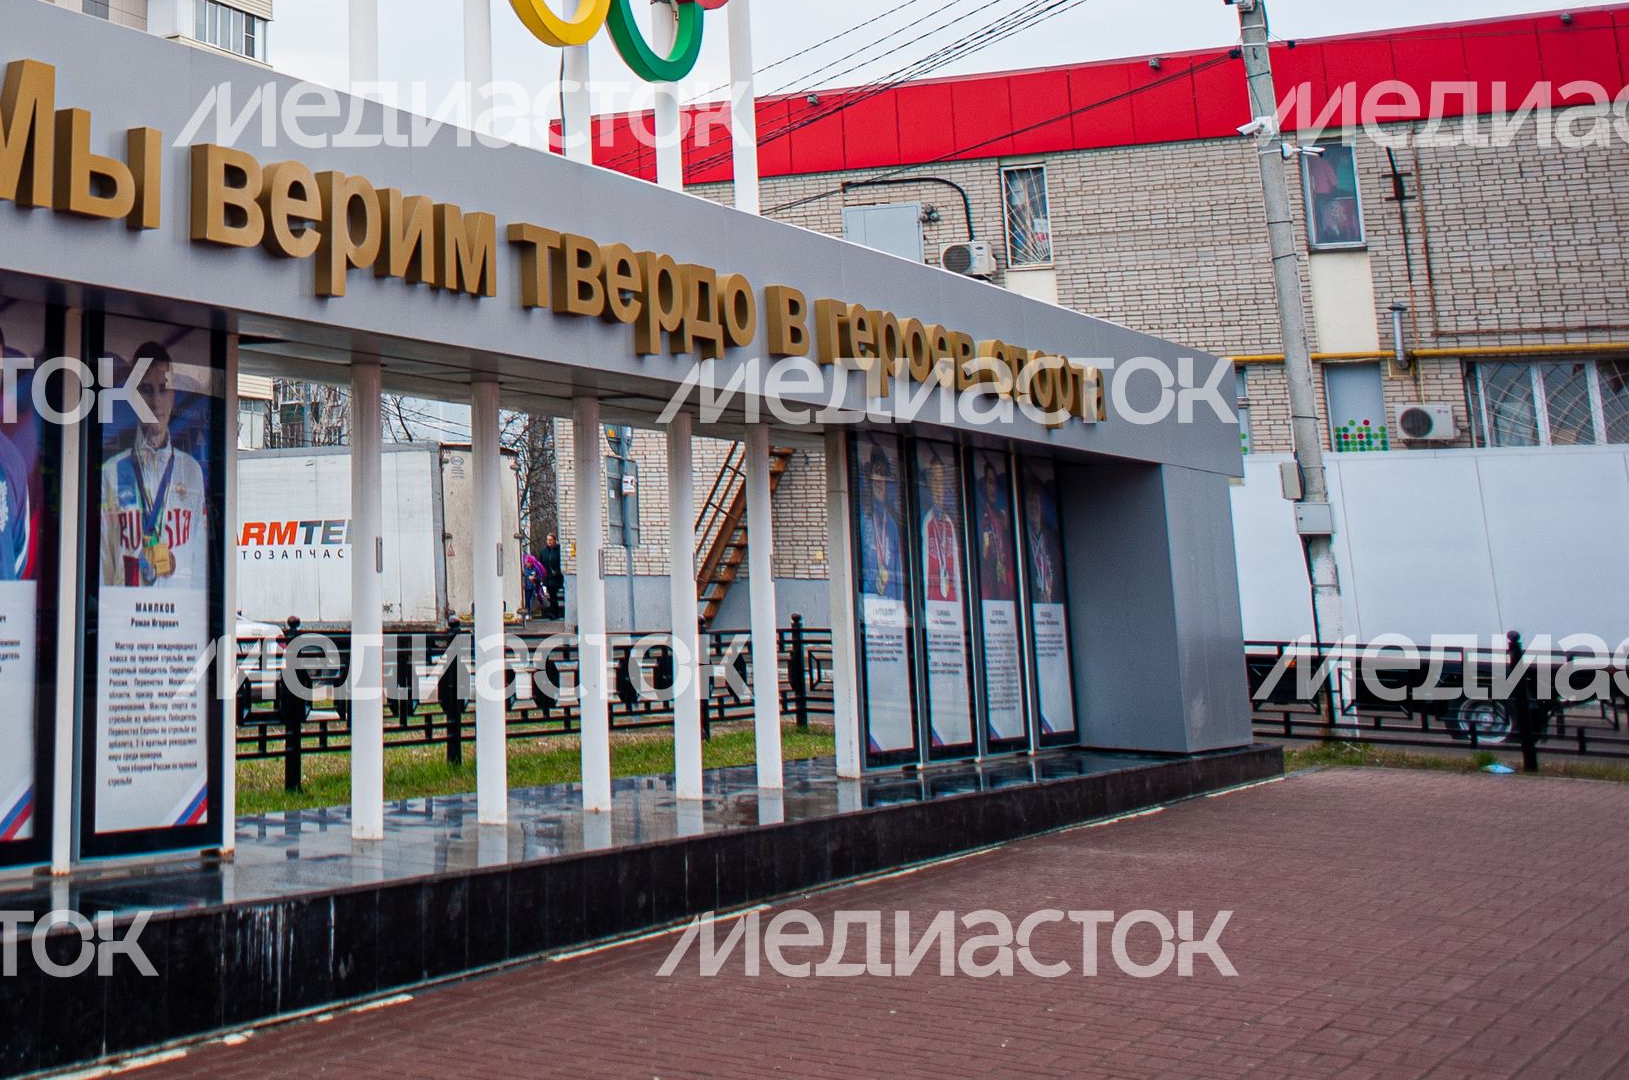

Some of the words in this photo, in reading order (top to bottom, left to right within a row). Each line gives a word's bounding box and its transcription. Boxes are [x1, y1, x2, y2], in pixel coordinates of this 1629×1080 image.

[191, 143, 497, 298] верим
[509, 222, 756, 359] твердо
[765, 284, 811, 356] в
[815, 298, 975, 398] героев
[131, 618, 150, 628] Роман
